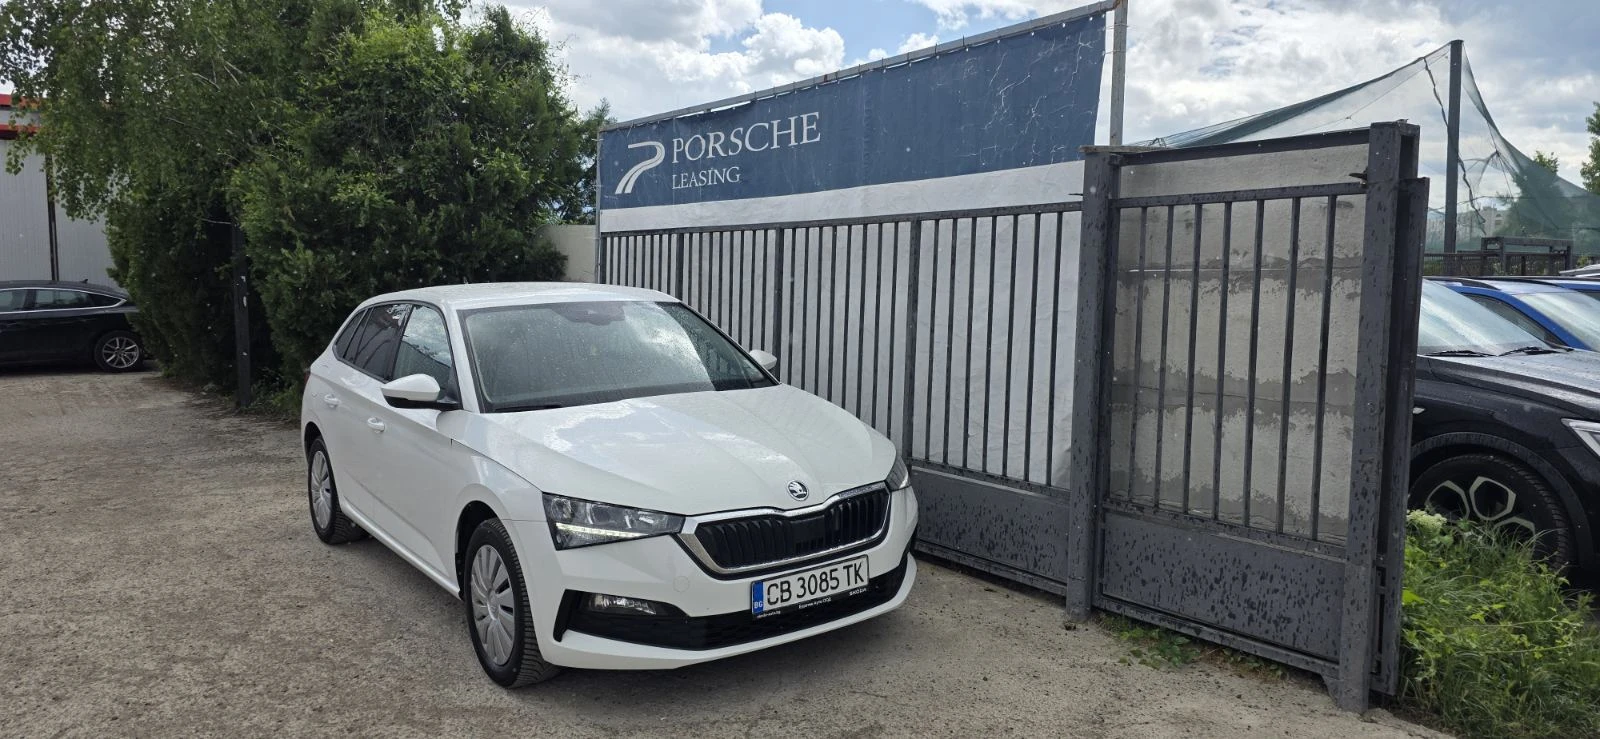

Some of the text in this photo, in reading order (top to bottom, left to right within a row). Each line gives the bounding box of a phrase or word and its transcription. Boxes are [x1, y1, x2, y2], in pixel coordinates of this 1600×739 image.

[671, 111, 821, 164] PORSCHE
[671, 166, 741, 190] LEASING
[766, 562, 865, 606] CB 3085 TK
[753, 601, 763, 609] BG
